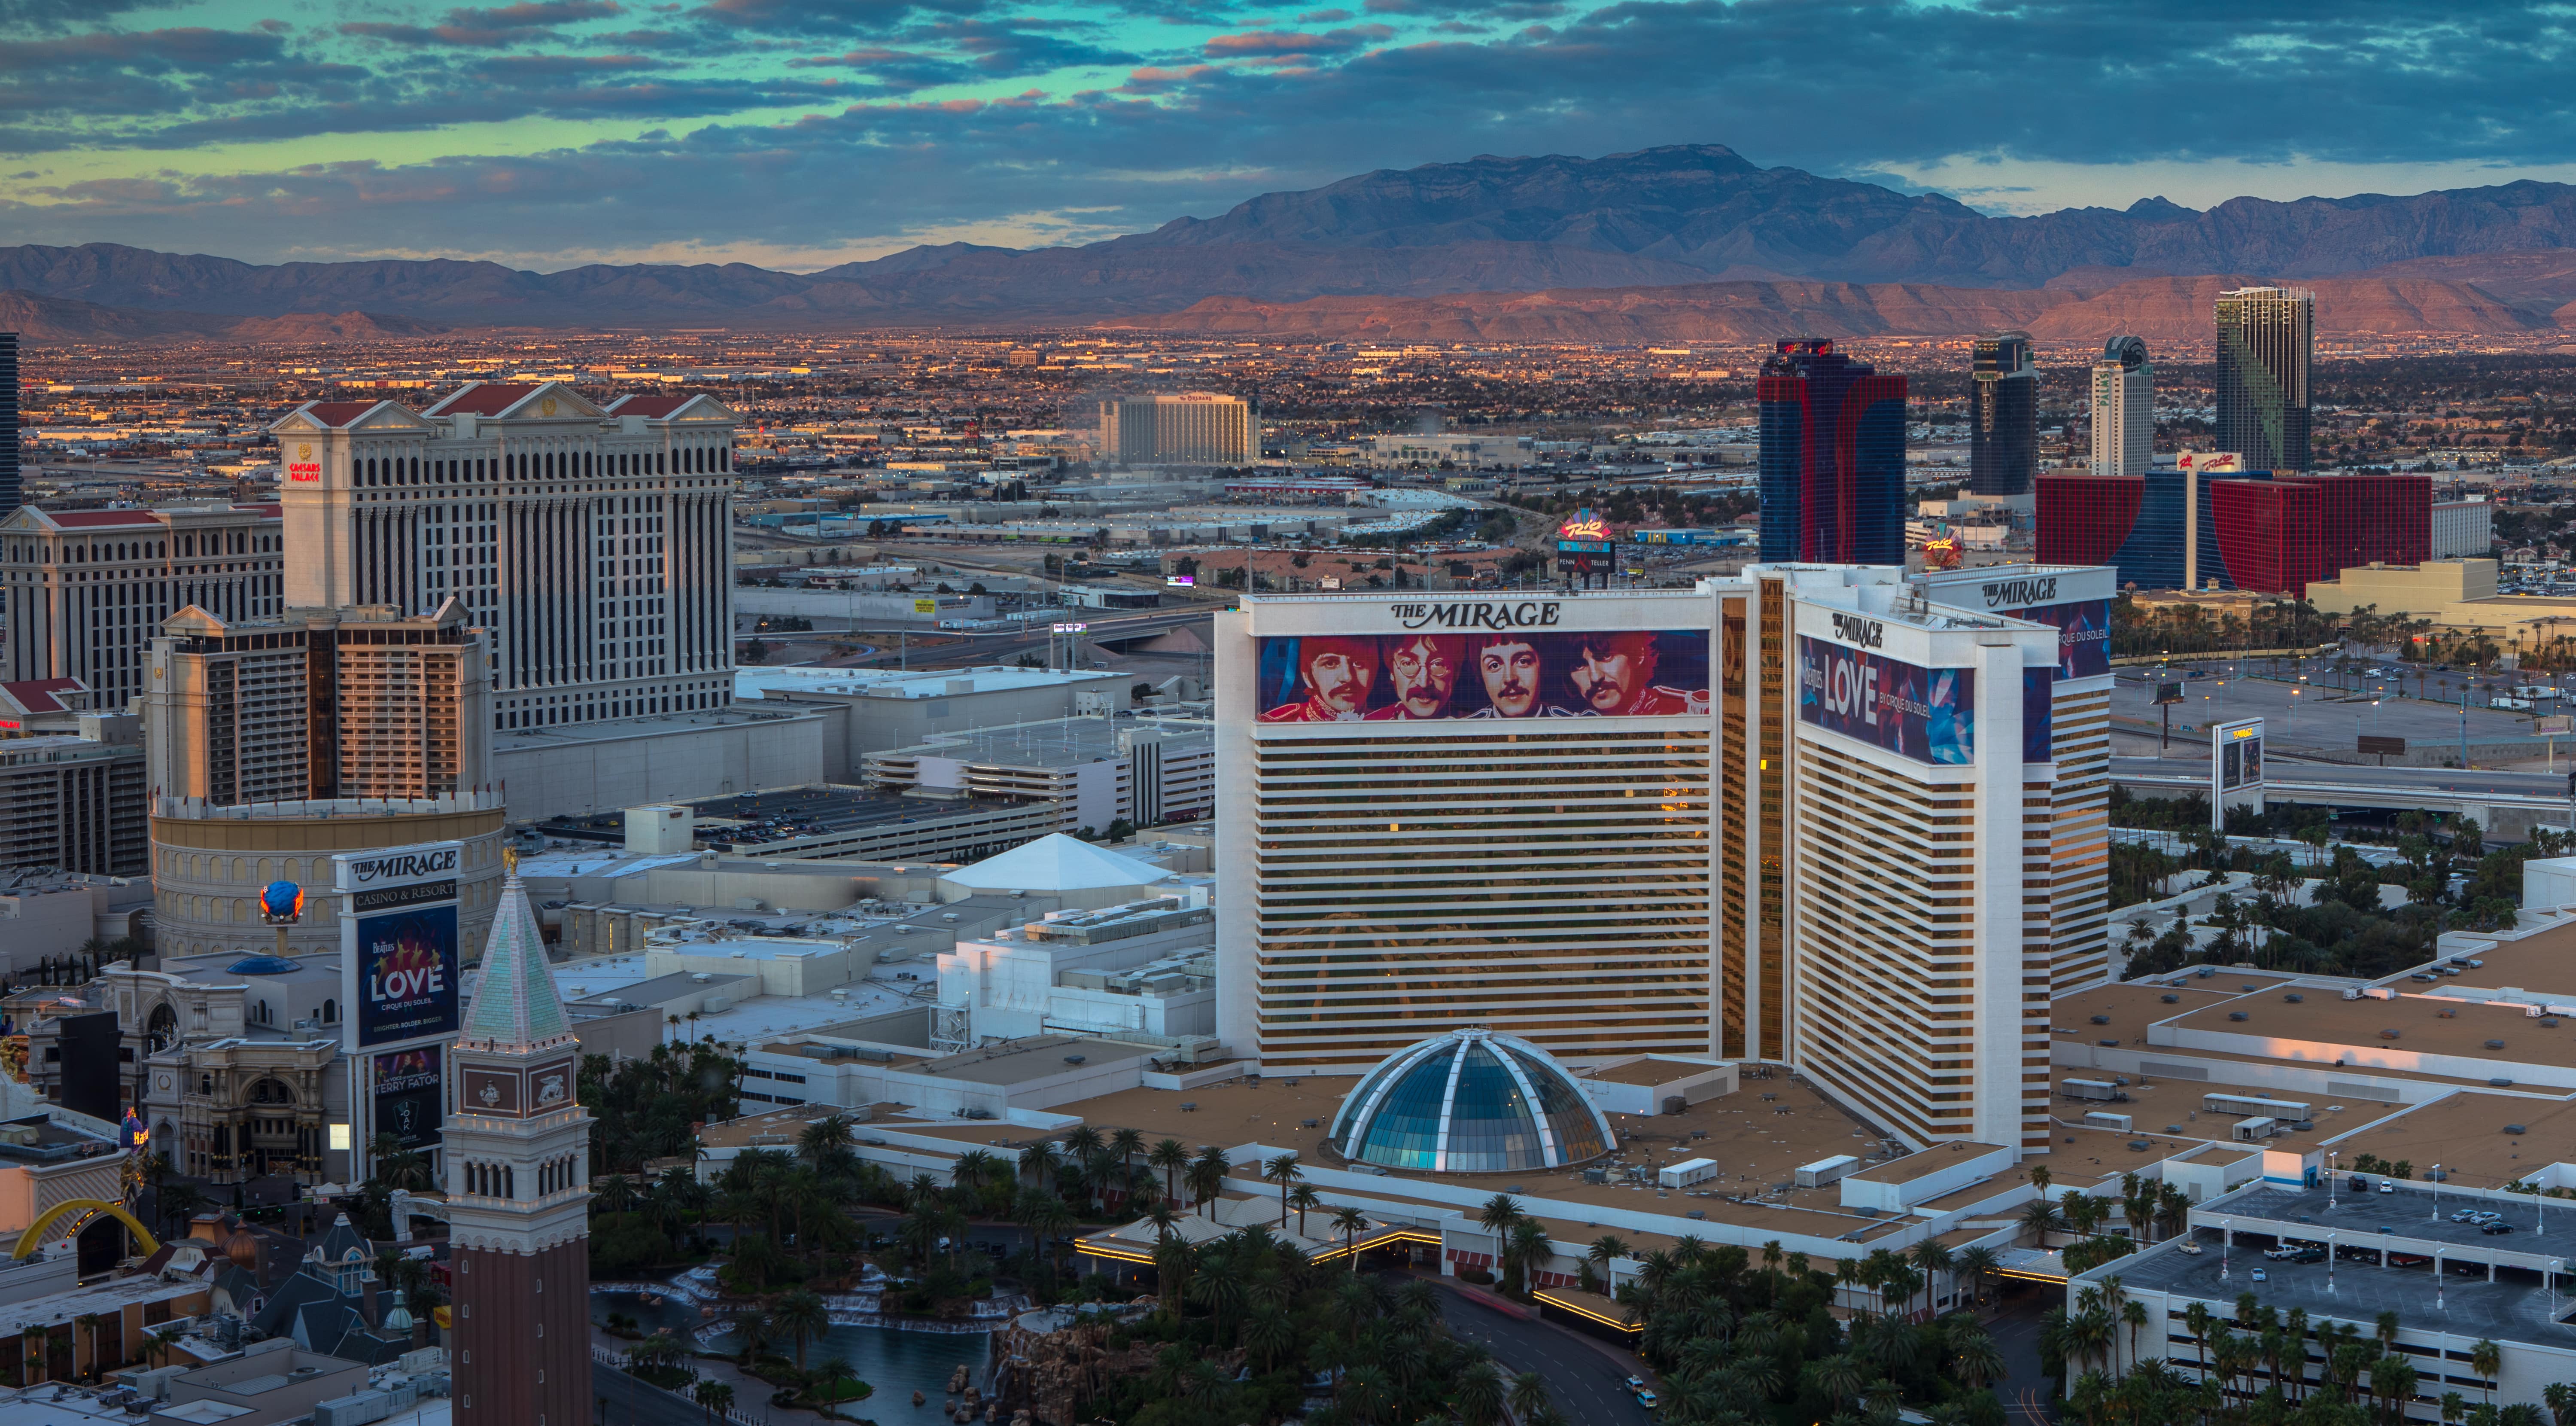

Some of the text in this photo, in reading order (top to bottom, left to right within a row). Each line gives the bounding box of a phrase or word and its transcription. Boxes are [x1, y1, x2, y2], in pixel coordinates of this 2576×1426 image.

[2099, 373, 2109, 406] PALMS
[289, 463, 320, 472] CAESARS
[2202, 454, 2235, 471] Rio
[291, 472, 319, 482] PALACE
[1565, 518, 1603, 539] Rio
[1578, 542, 1604, 551] WOW
[1926, 537, 1953, 551] Rio
[1982, 578, 2056, 607] THE MIRAGE
[1391, 602, 1560, 630] THE MIRAGE
[1832, 612, 1883, 648] THE MIRAGE
[2059, 629, 2108, 646] RQUE DU SOLEIL
[1805, 656, 1822, 692] BEATLES
[1825, 654, 1877, 725] LOVE
[1880, 692, 1931, 718] BY CIRQUE DU SOLEIL
[2234, 728, 2253, 739] MIRAGE
[352, 850, 456, 882] THE MIRAGE
[356, 883, 455, 906] CASINO & RESORT
[373, 942, 394, 954] BEATLES
[371, 964, 444, 1002] LOVE
[381, 1002, 402, 1011] CIRQUE
[413, 997, 432, 1006] SOLEIL
[374, 1016, 443, 1032] BRIGHTER. BOLDER. BIGGER.
[374, 1074, 439, 1094] TERRY FATOR
